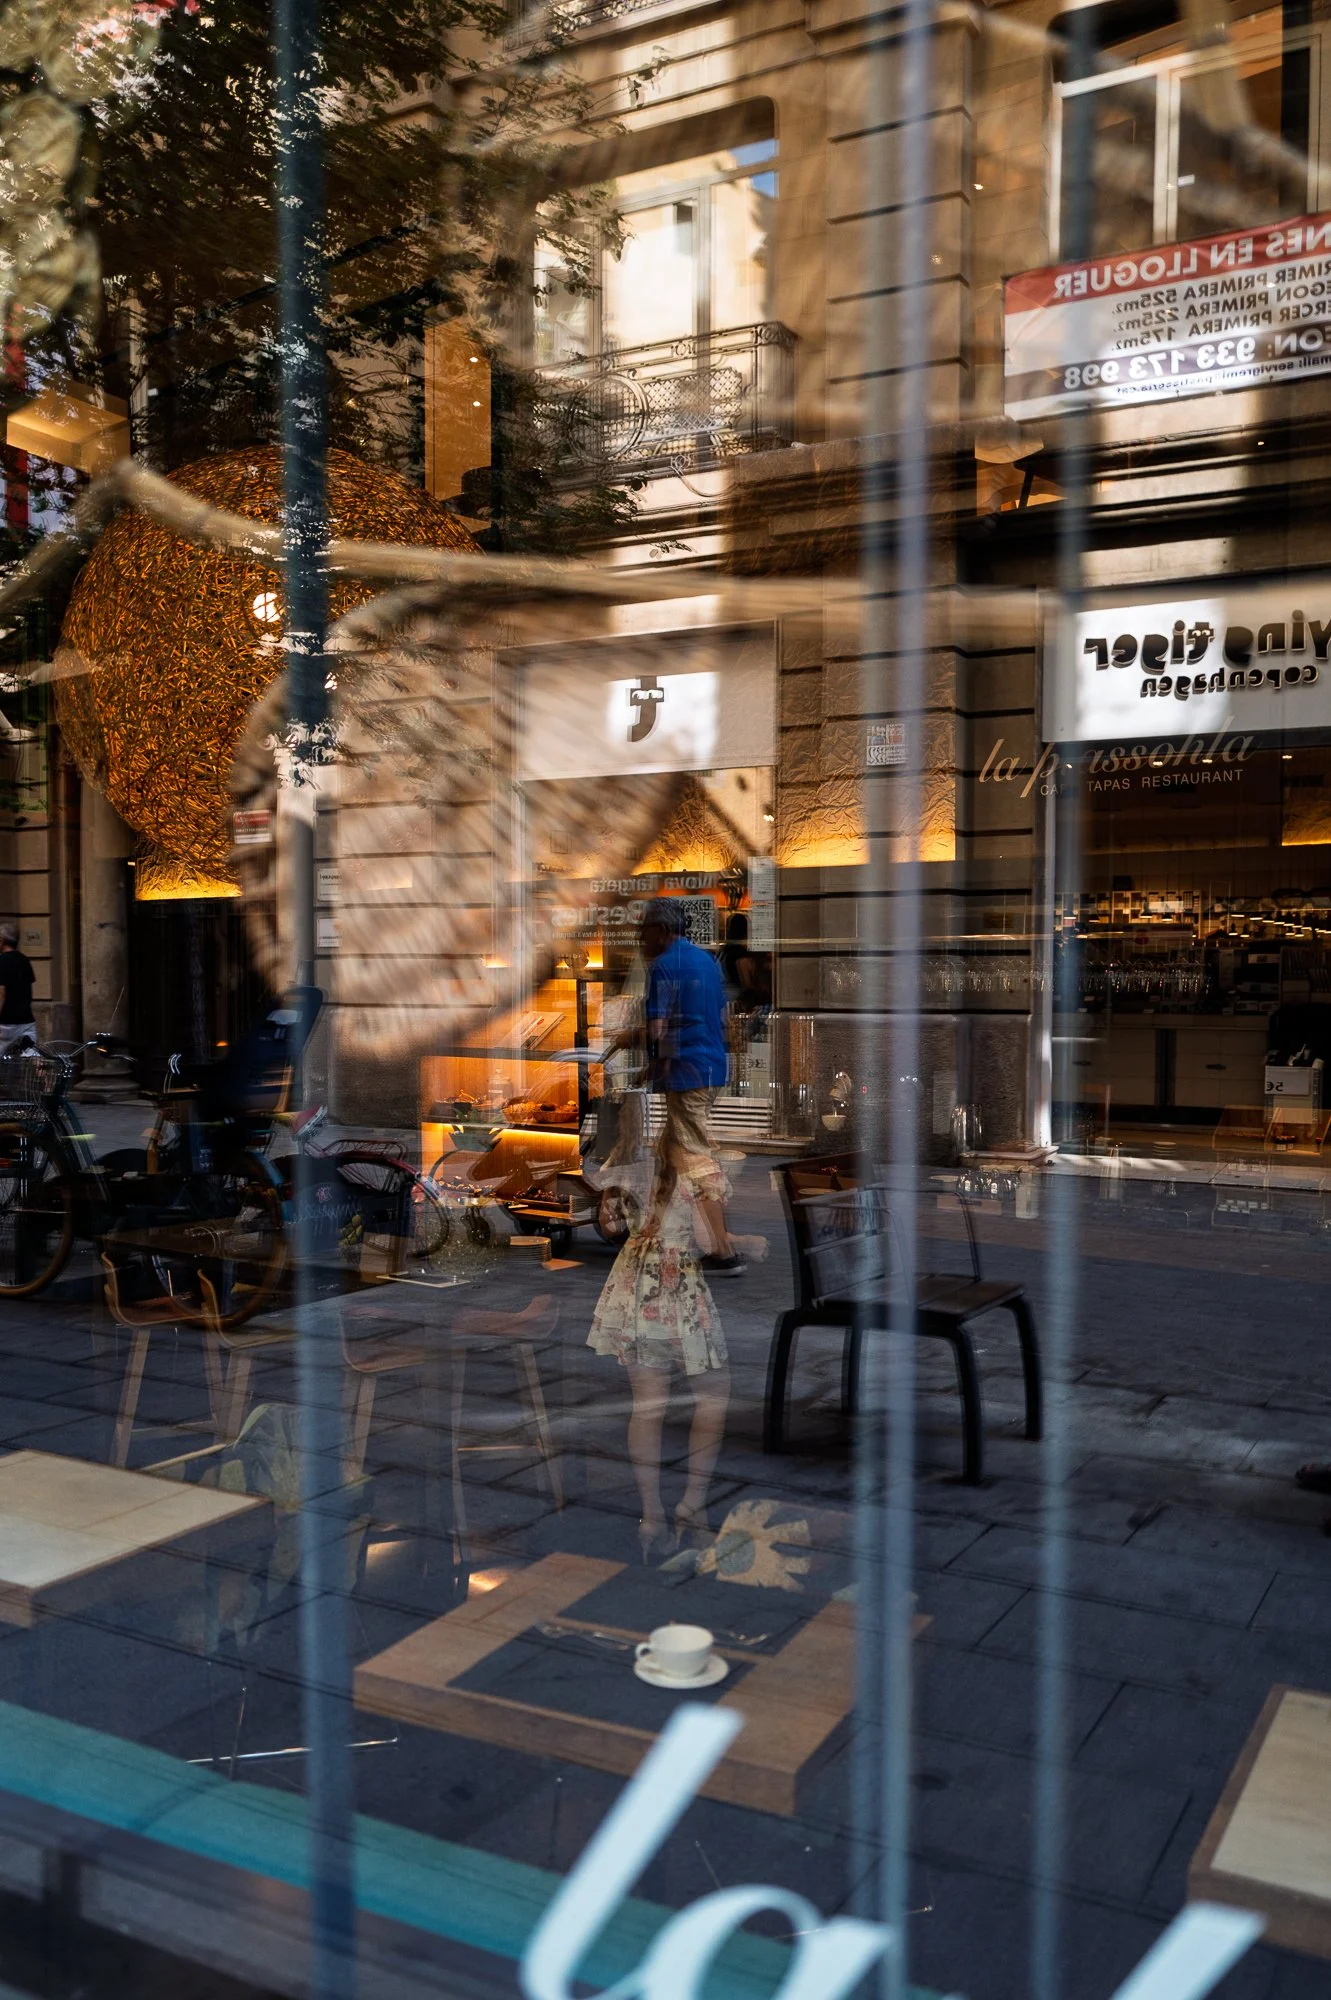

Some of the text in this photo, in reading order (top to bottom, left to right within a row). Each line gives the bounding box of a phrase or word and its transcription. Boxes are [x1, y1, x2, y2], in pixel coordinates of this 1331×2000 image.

[978, 738, 1027, 784] la
[1086, 778, 1131, 792] TAPAS
[1142, 769, 1244, 788] RESTAURANT
